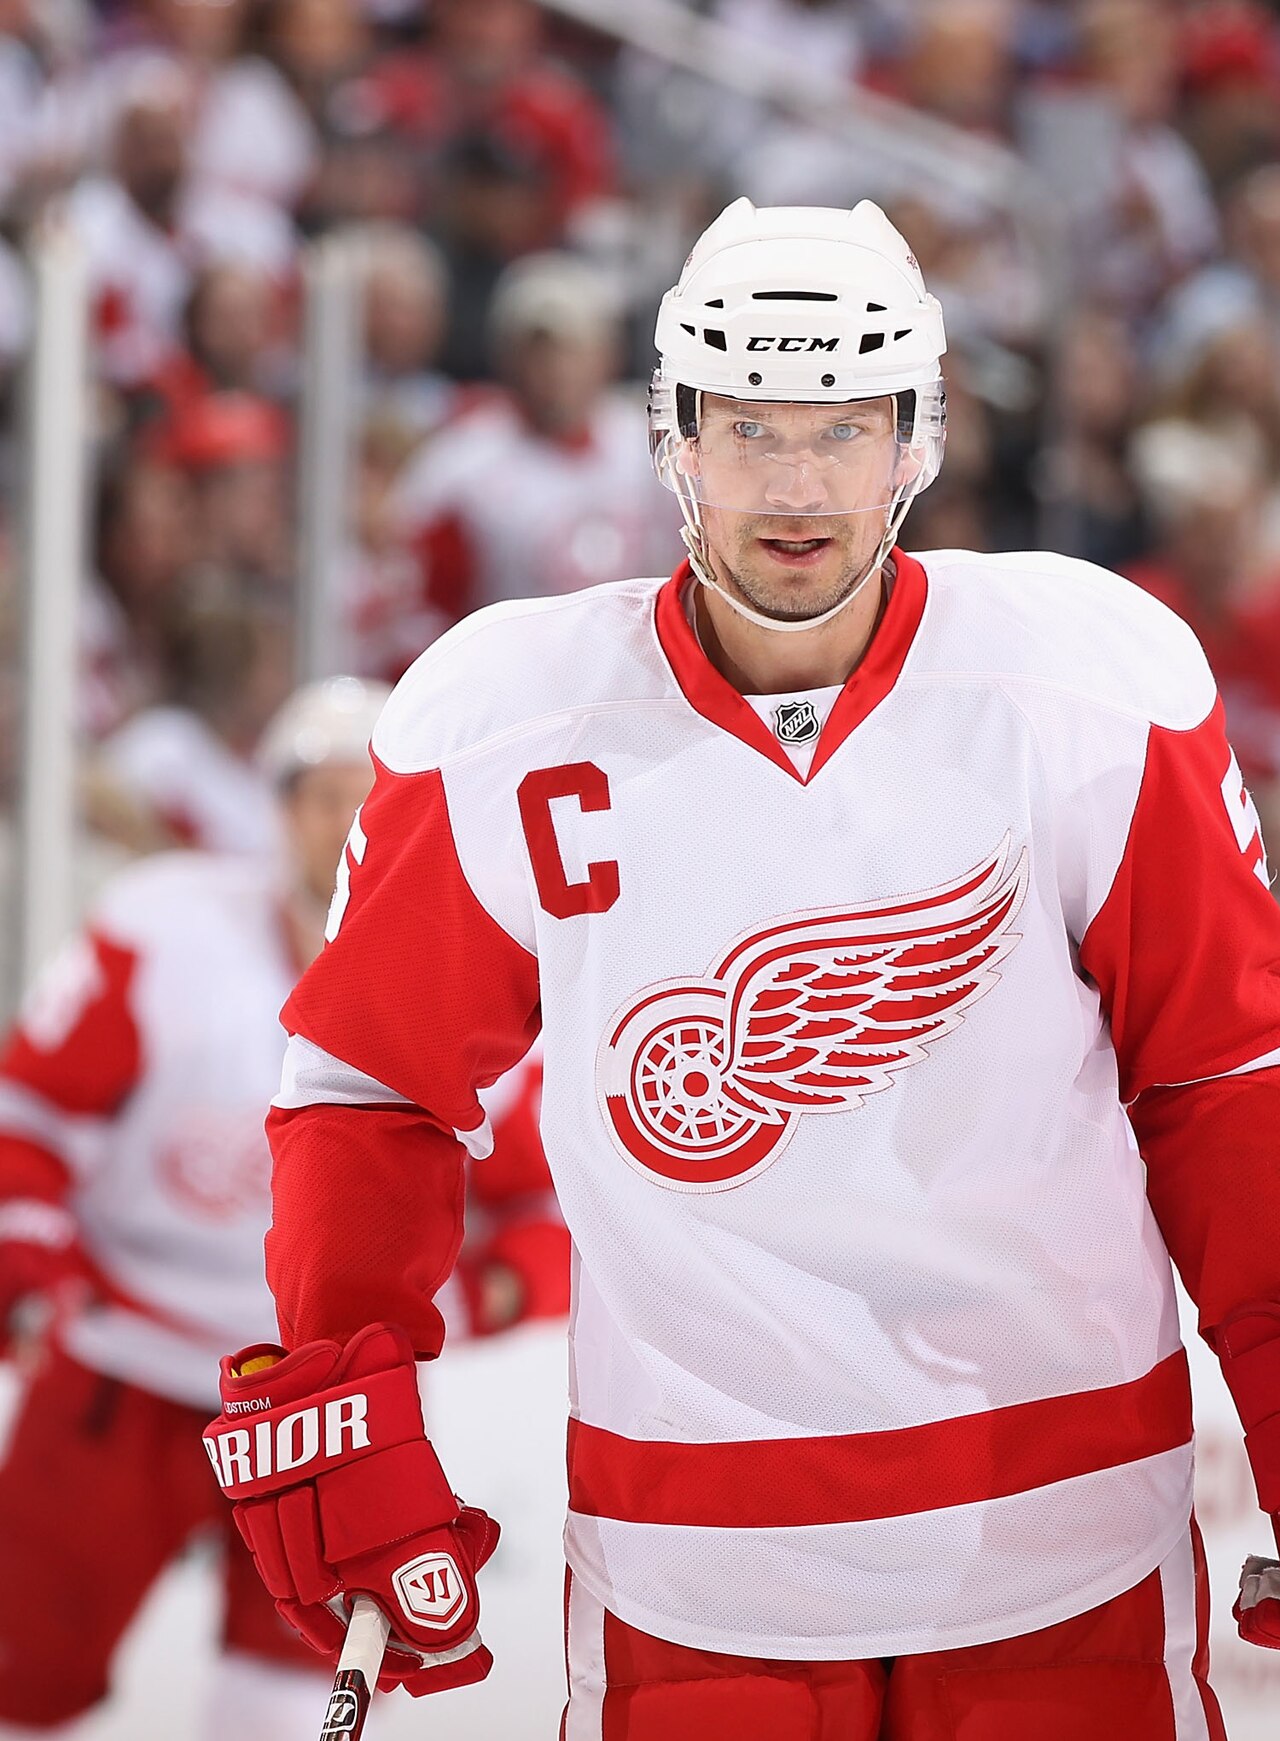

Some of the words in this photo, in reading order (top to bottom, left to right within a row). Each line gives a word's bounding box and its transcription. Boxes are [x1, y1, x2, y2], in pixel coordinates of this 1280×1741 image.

[746, 337, 840, 352] CCM
[784, 709, 811, 737] NHL
[516, 761, 620, 920] C
